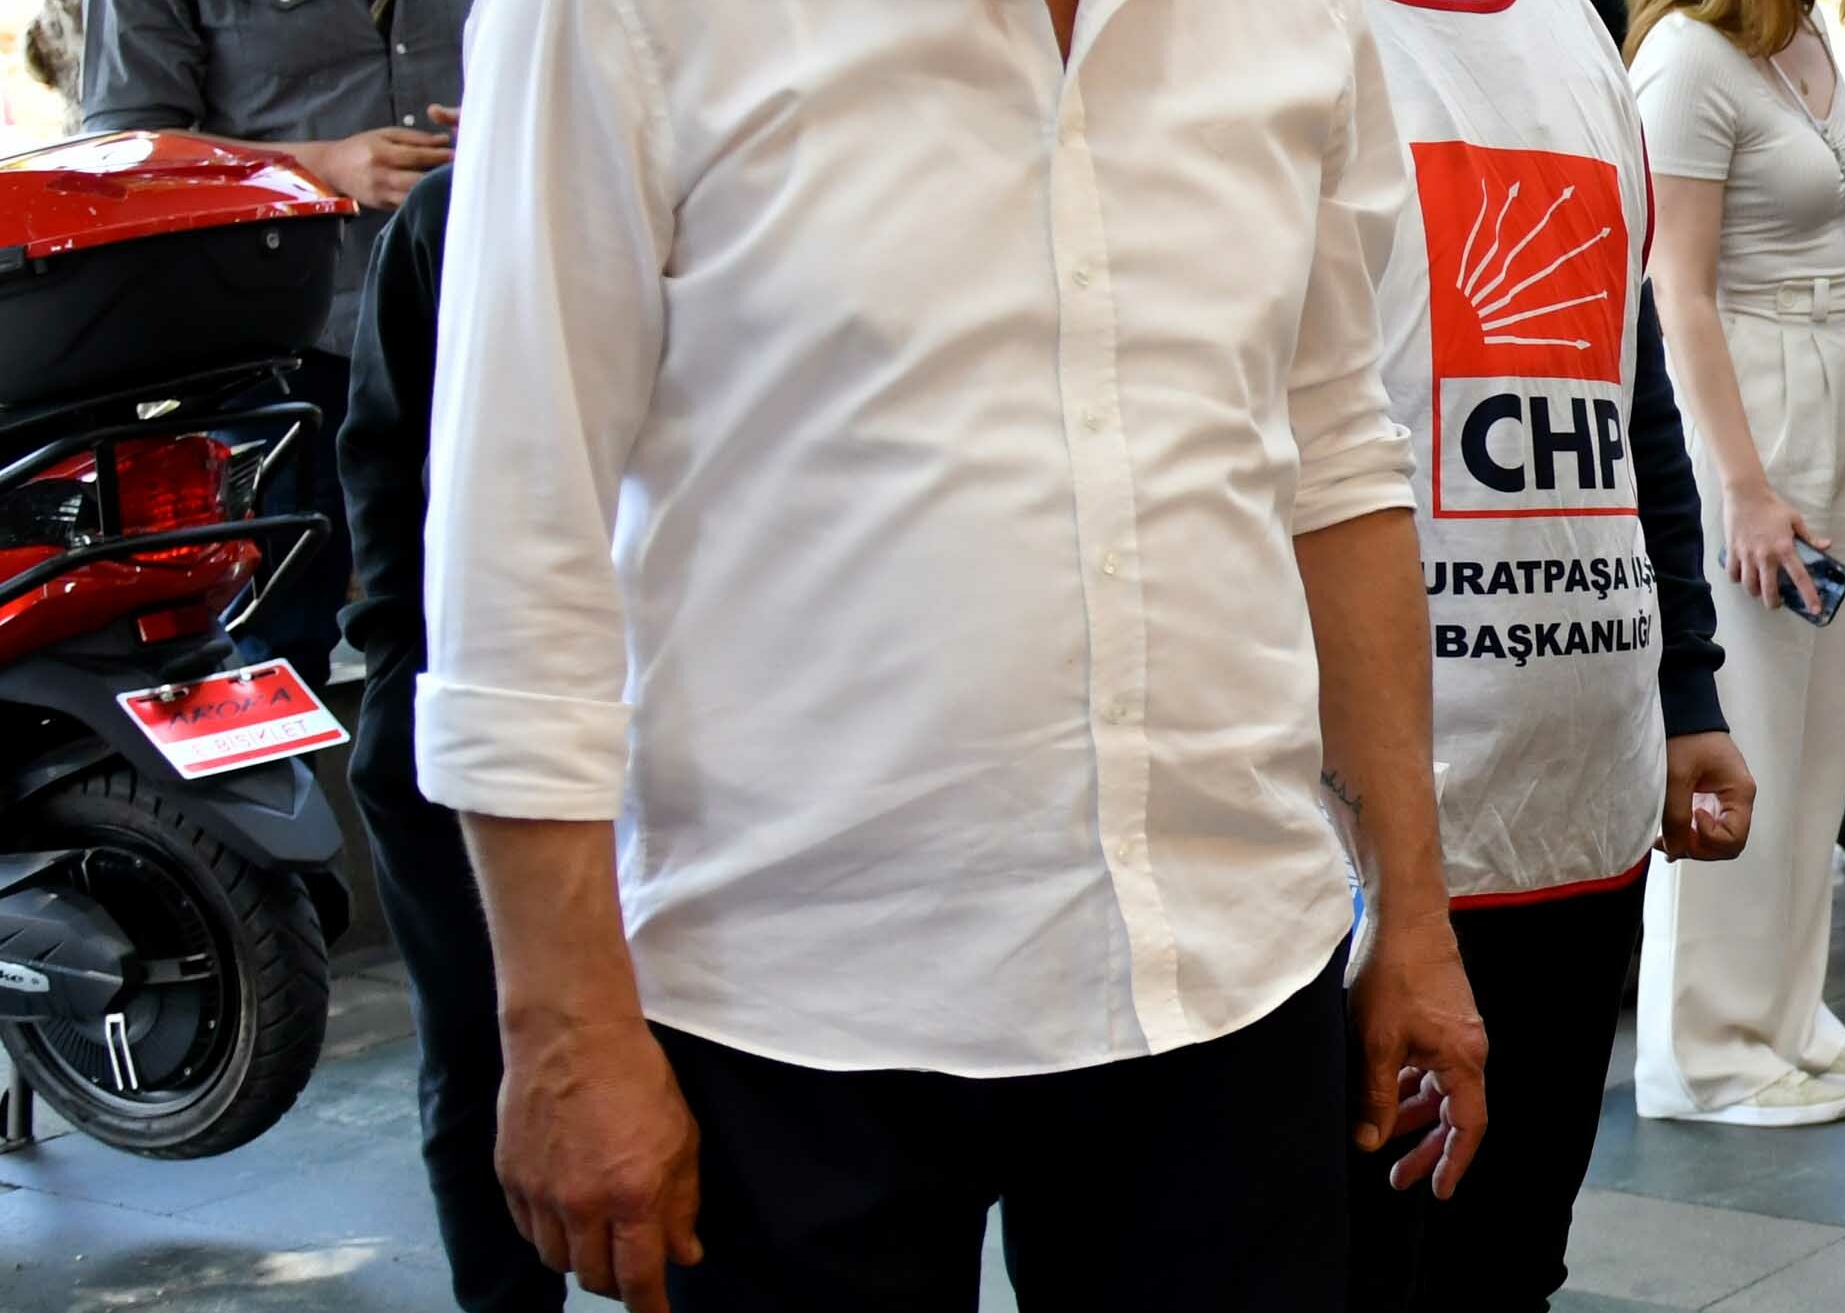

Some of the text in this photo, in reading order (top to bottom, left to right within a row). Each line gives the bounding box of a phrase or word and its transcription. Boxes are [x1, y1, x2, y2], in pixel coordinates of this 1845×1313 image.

[1461, 393, 1624, 493] CHP
[1421, 556, 1629, 601] URATPAŞA
[1435, 608, 1652, 667] BAŞKANLIĞI
